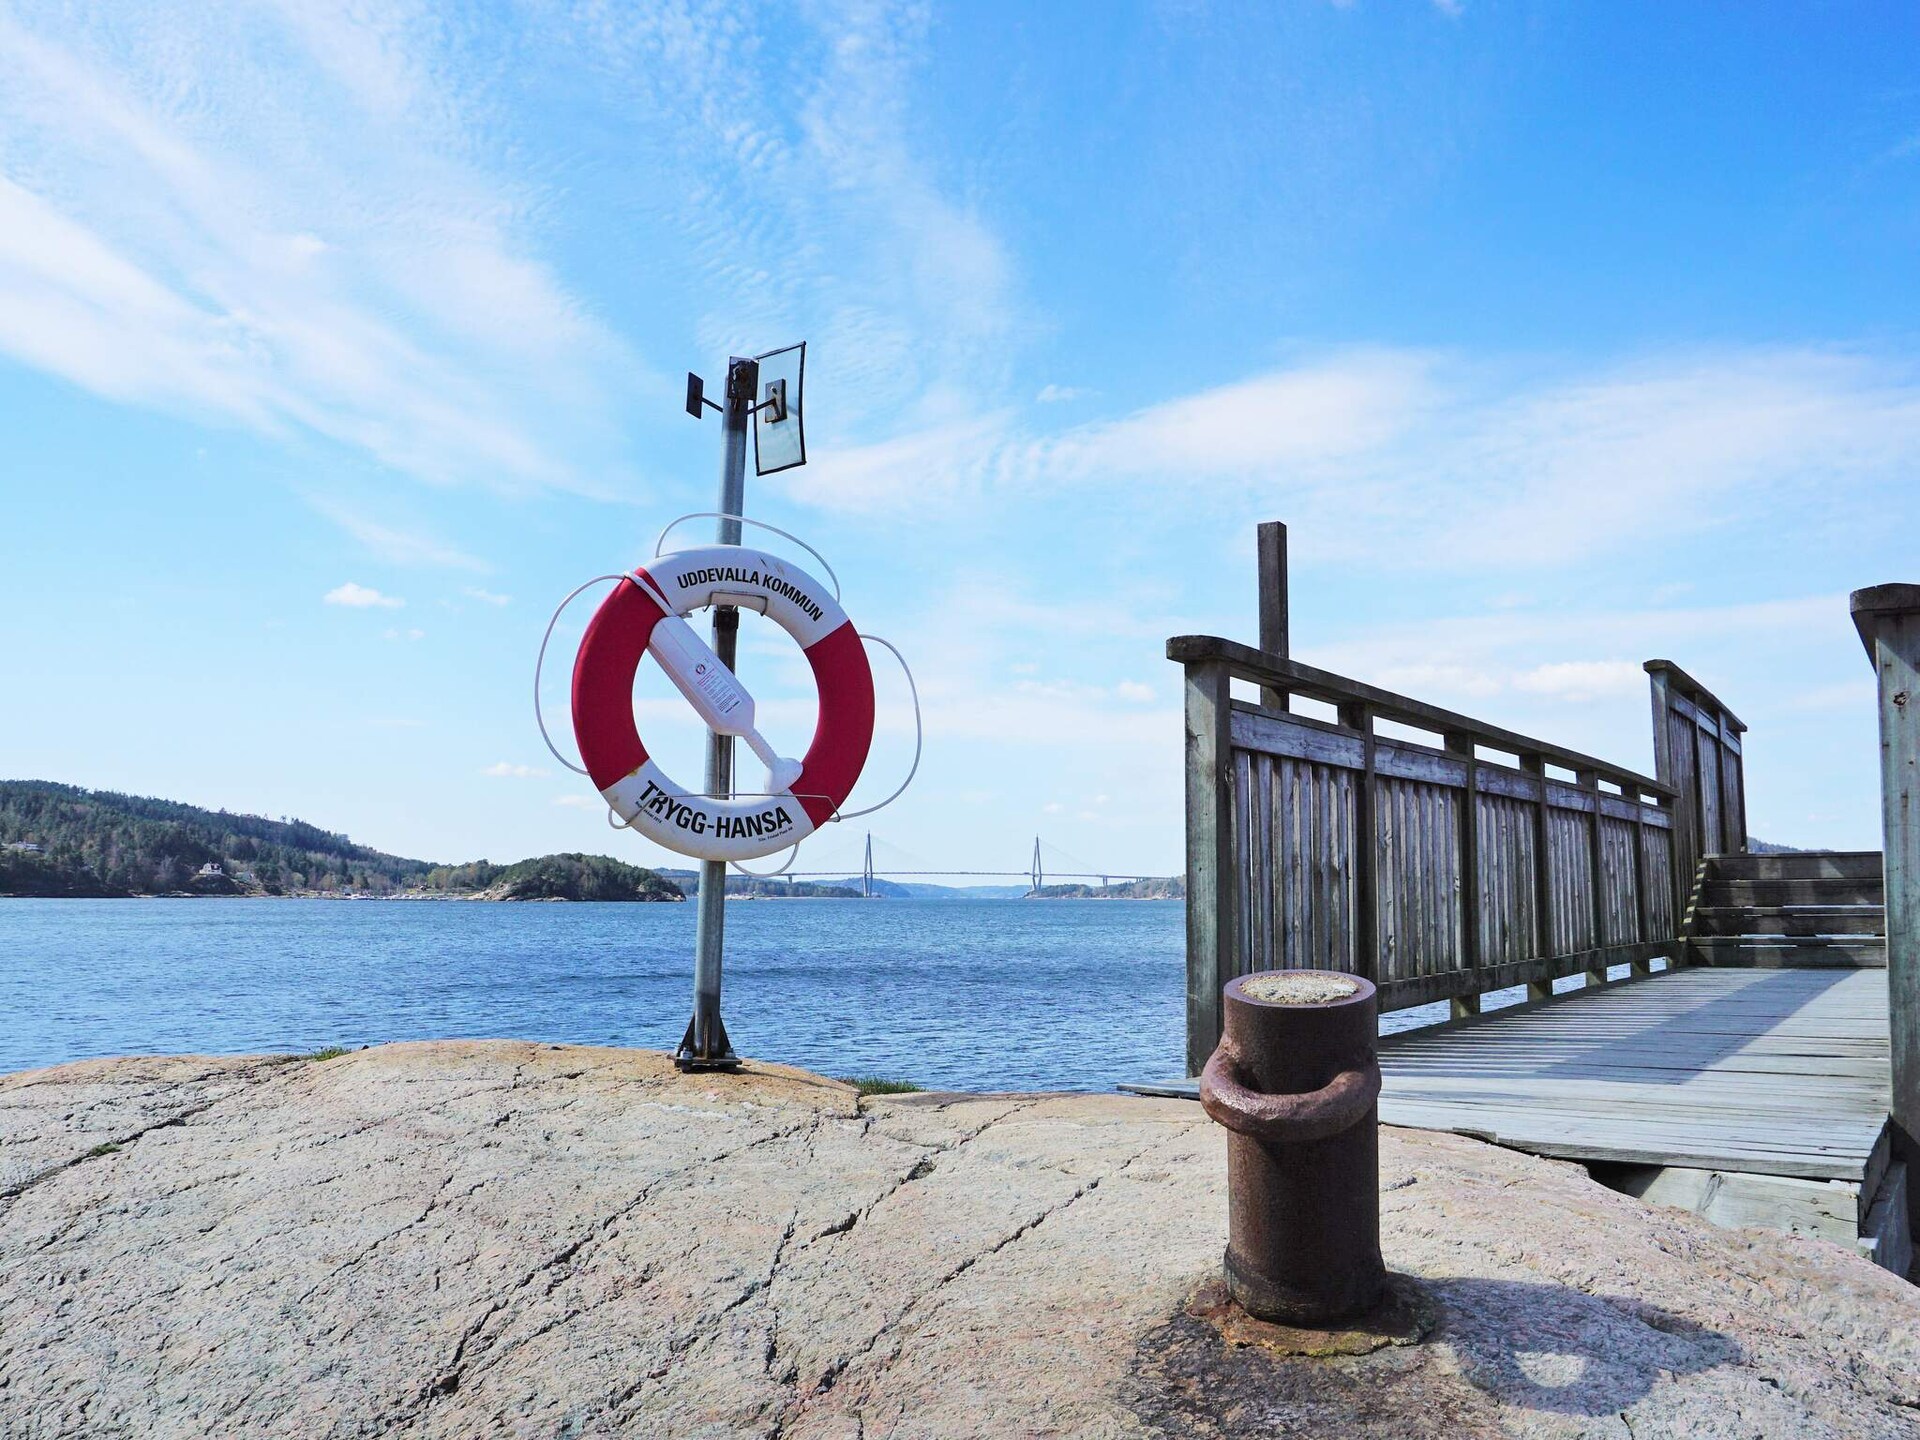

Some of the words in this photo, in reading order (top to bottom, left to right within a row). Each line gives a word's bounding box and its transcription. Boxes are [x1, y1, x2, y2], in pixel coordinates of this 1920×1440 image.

[677, 567, 760, 589] UDDEVALLA
[762, 574, 824, 622] KOMMUN
[639, 779, 793, 839] TRYGG-HANSA
